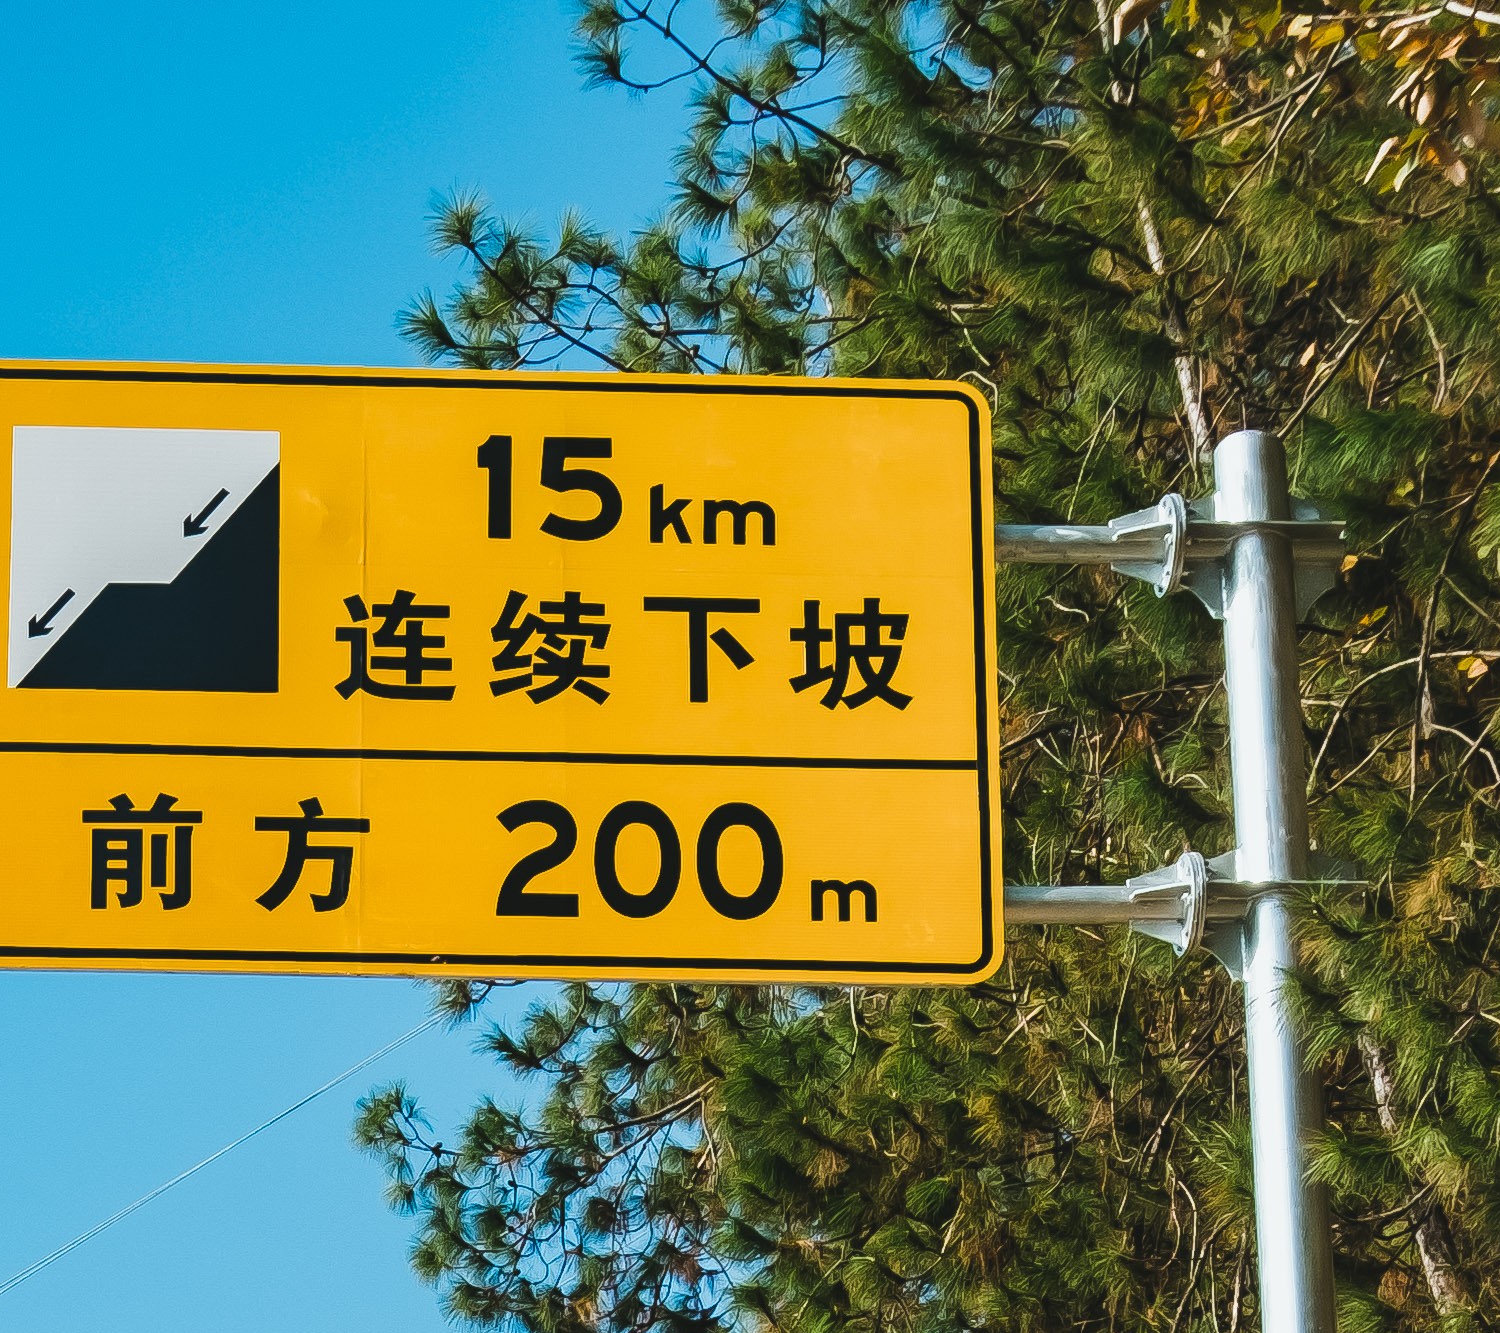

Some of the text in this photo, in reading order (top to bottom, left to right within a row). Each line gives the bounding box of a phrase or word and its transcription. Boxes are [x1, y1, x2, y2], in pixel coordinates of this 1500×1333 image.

[333, 588, 914, 712] 连续下坡
[80, 791, 372, 914] 前方
